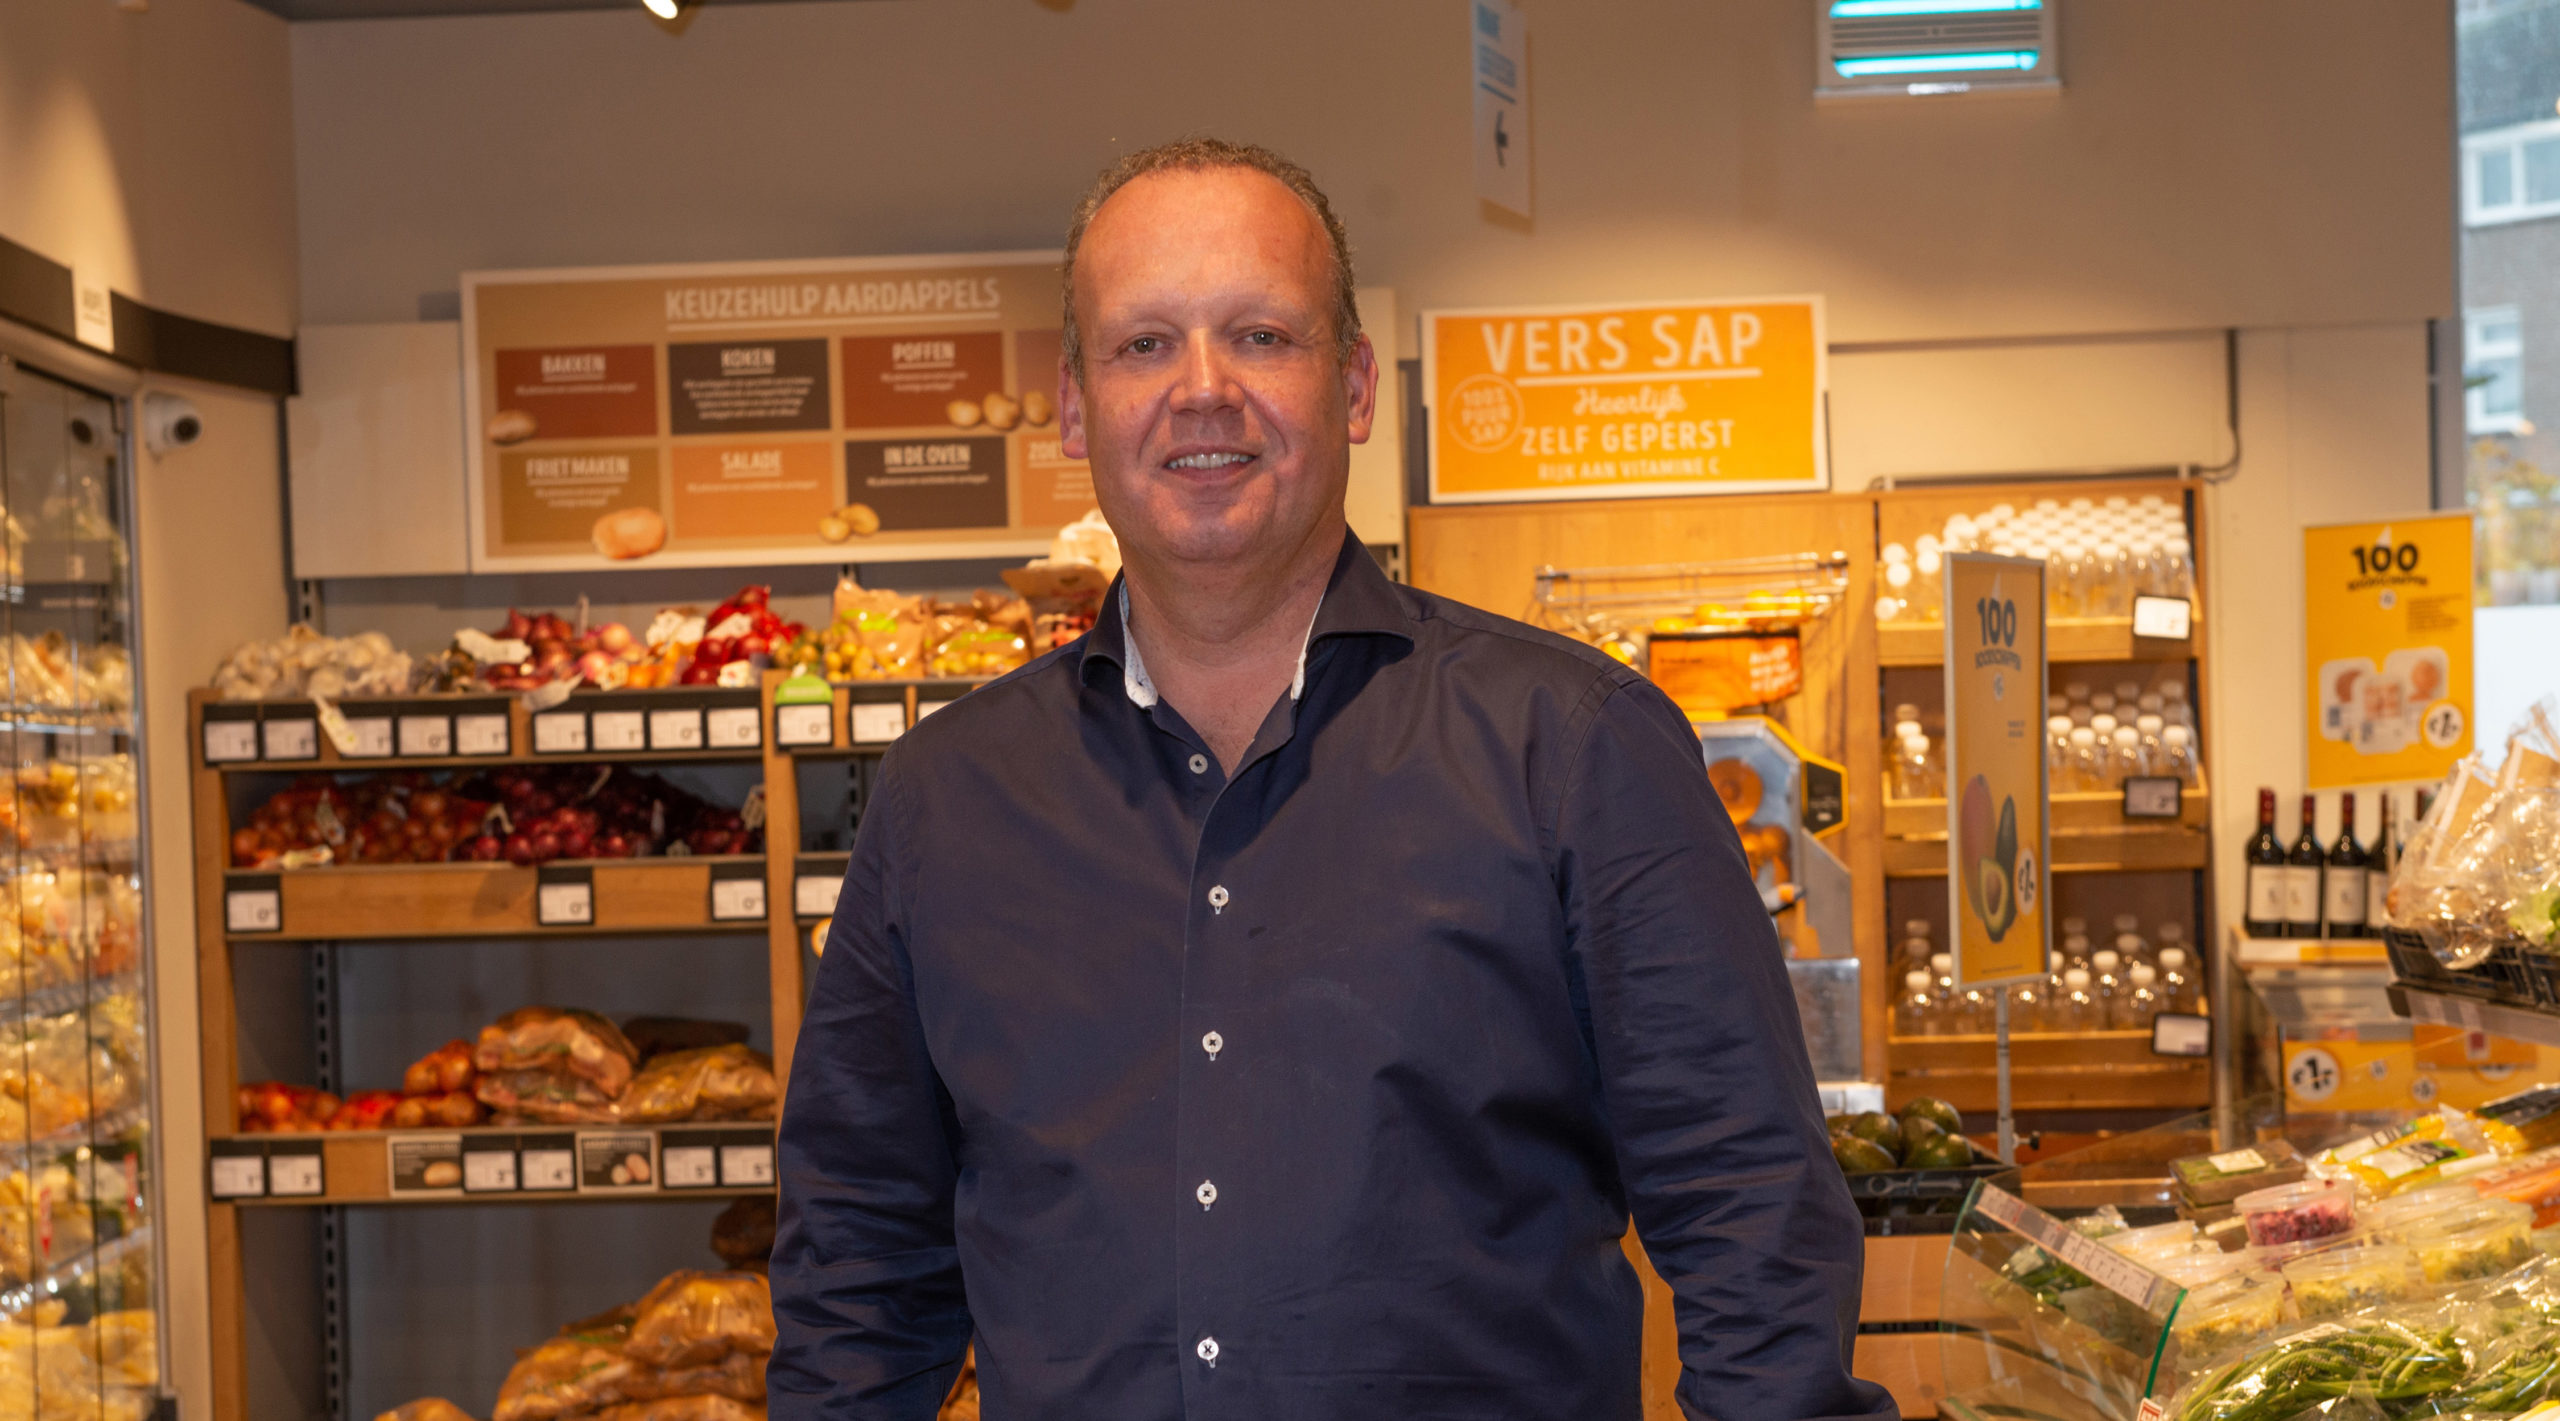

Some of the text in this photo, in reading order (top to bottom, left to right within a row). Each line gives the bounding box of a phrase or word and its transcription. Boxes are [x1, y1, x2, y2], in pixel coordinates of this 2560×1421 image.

[666, 277, 999, 320] KEUZEHULP AARDAPPELS
[1481, 312, 1763, 374] VERS SAP
[541, 353, 606, 374] BAKKEN
[1572, 384, 1688, 421] Heerlijk
[926, 444, 970, 464] OVEN
[1521, 419, 1735, 456] ZELF GEPERST
[572, 456, 629, 476] MAKEN
[1580, 460, 1617, 479] AAN
[1619, 456, 1704, 477] VITAMINE
[1707, 455, 1720, 475] C
[2351, 543, 2419, 574] 100
[1976, 597, 2017, 647] 100
